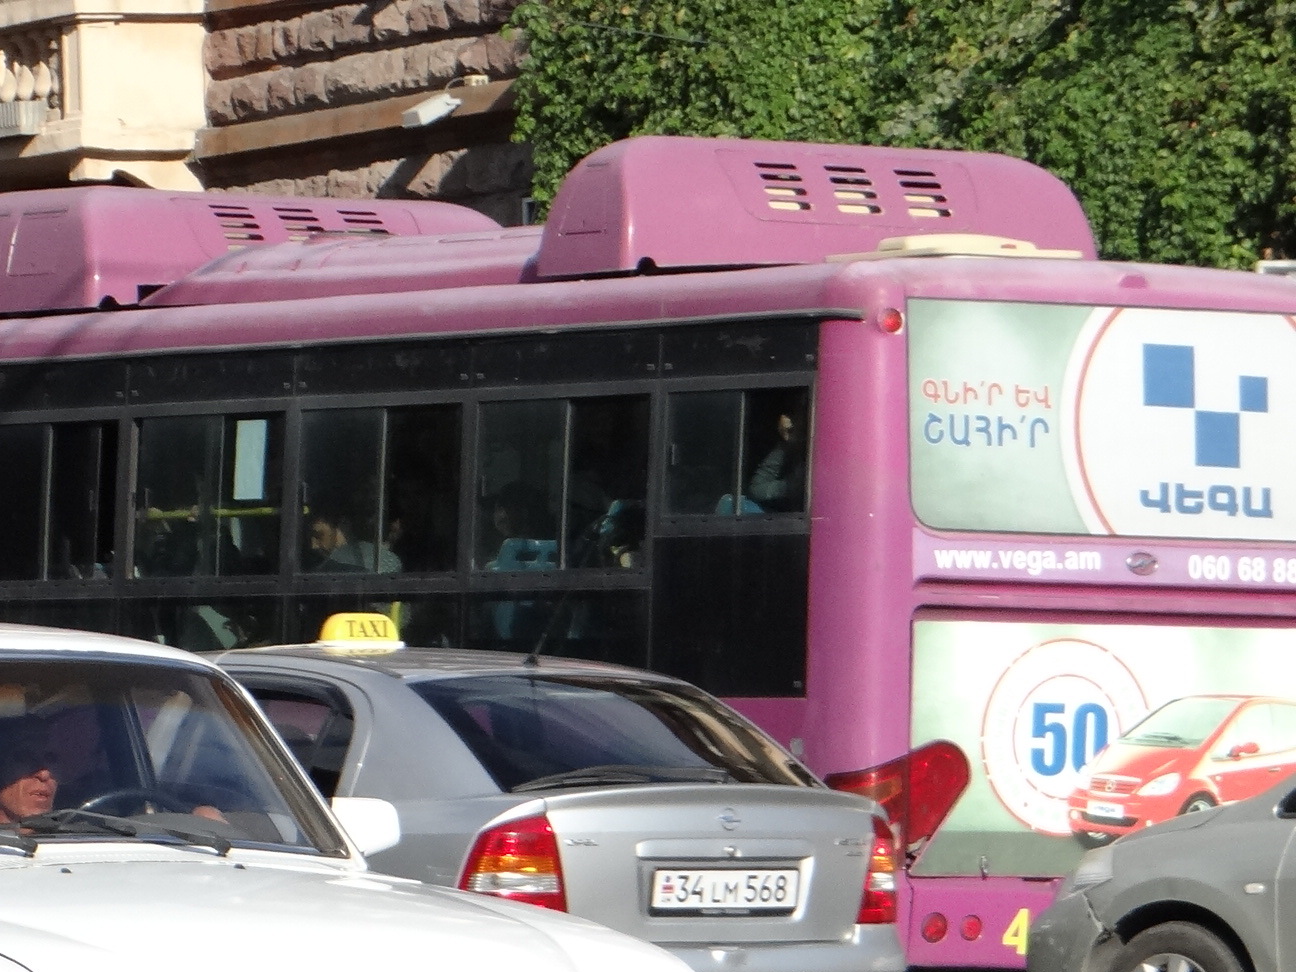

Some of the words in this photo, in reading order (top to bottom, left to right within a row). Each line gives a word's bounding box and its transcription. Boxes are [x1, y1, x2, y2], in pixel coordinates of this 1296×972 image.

[1014, 384, 1052, 409] ԵՎ
[1139, 481, 1274, 519] ՎԵԳԱ
[934, 549, 1101, 575] www.vega.am
[1188, 555, 1230, 581] 060
[1237, 557, 1266, 582] 68
[345, 619, 388, 638] TAXI
[1030, 702, 1109, 776] 50
[676, 875, 704, 903] 34
[711, 882, 739, 903] LM
[745, 875, 787, 902] 568
